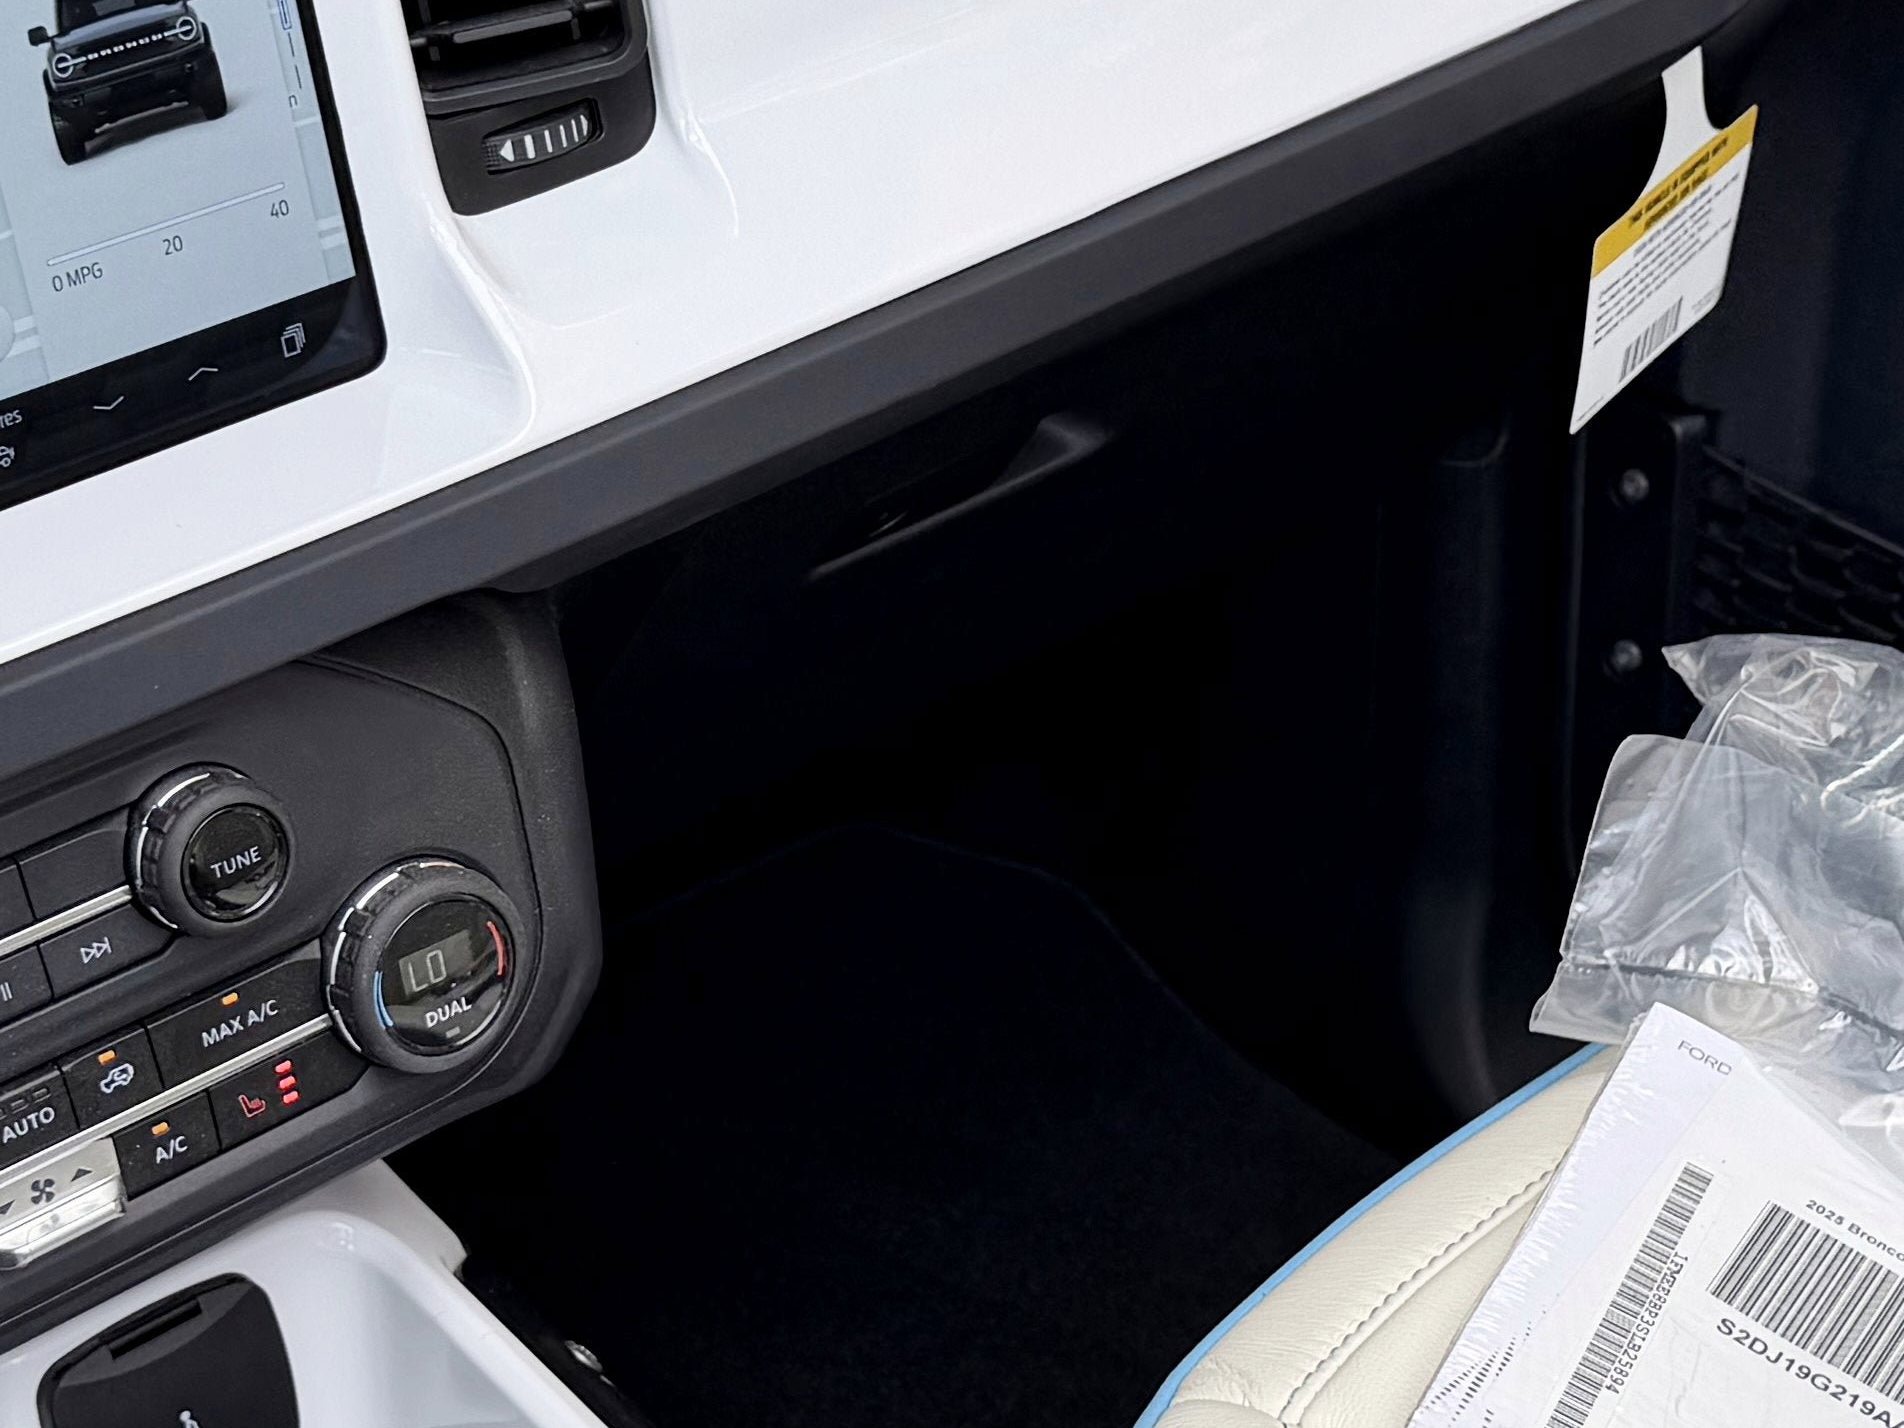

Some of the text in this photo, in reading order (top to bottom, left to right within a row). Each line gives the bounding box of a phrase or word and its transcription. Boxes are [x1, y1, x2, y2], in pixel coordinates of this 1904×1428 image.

[270, 199, 290, 221] 40
[164, 234, 184, 257] 20
[52, 263, 104, 293] 0 MPG
[210, 846, 262, 879] TUNE
[202, 999, 279, 1048] MAX A/C
[425, 996, 473, 1027] DUAL
[1677, 1039, 1733, 1076] FORD
[1, 1105, 55, 1143] AUTO
[155, 1135, 188, 1164] A/C
[1806, 1199, 1845, 1225] 2025
